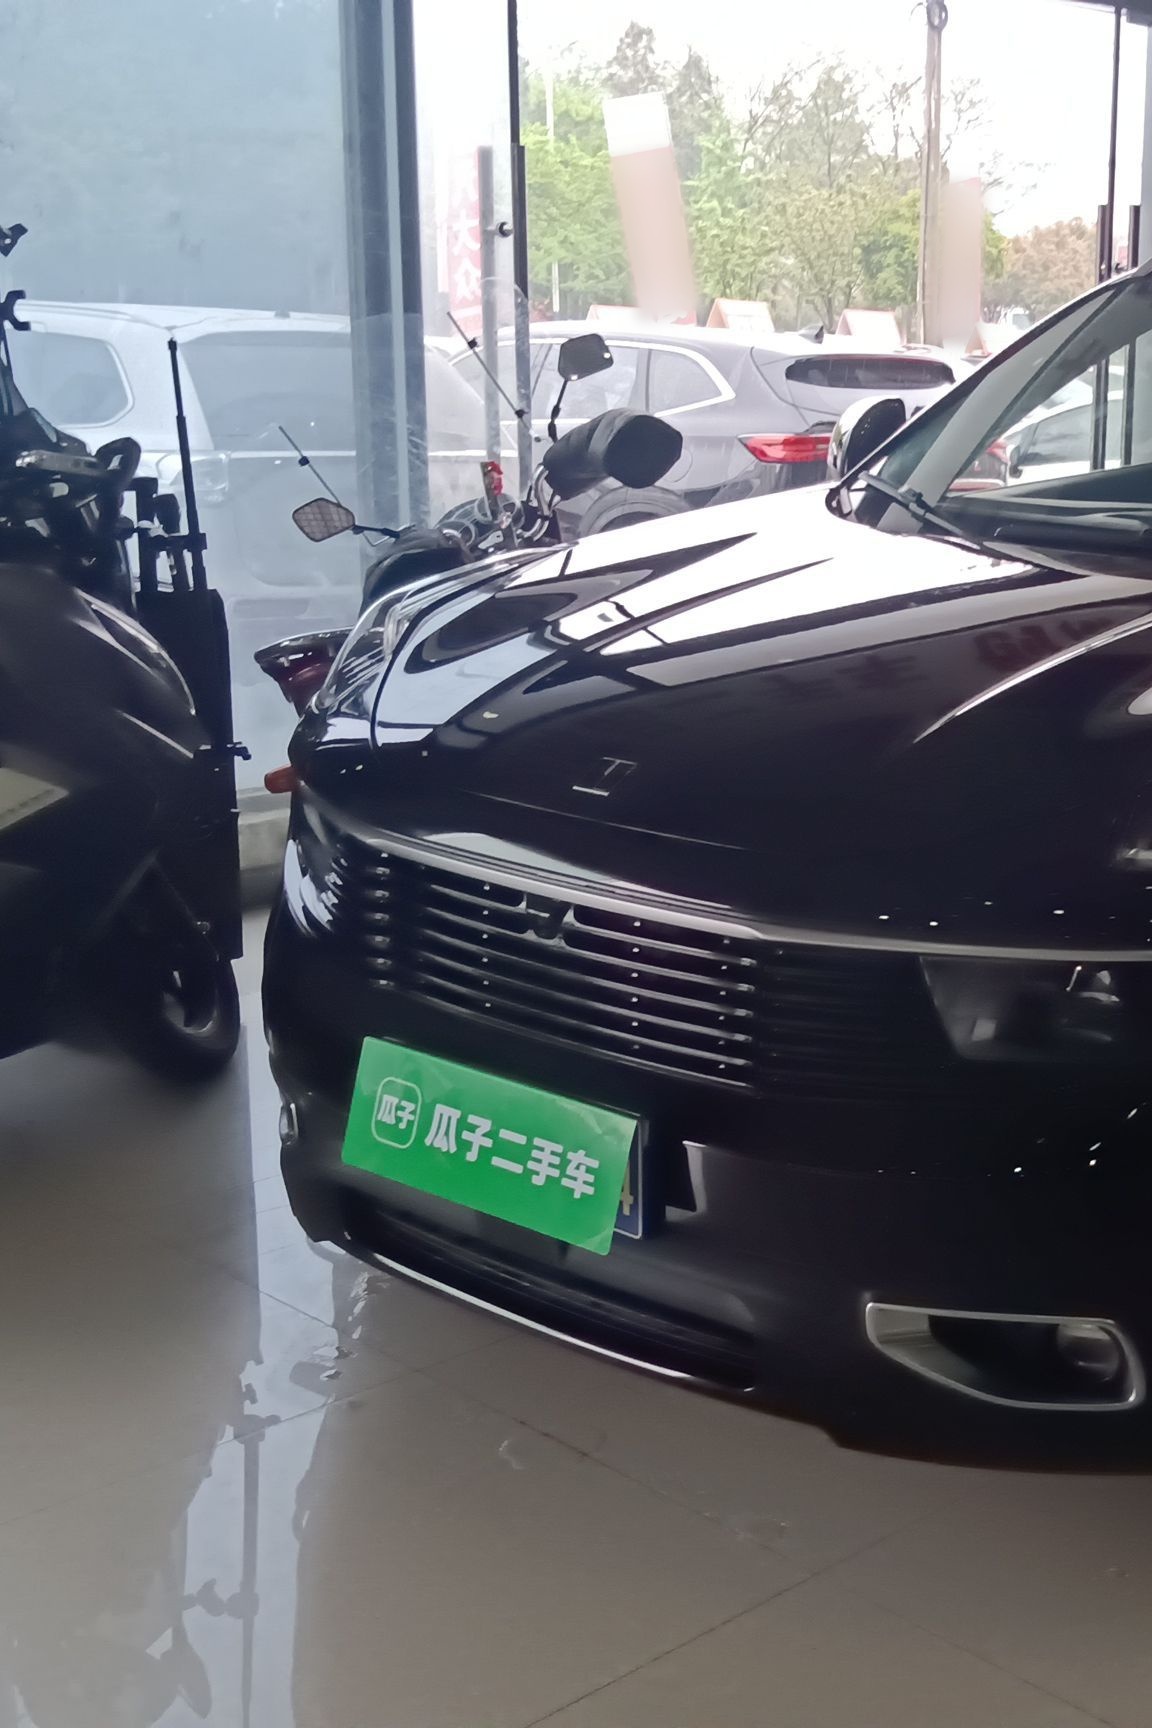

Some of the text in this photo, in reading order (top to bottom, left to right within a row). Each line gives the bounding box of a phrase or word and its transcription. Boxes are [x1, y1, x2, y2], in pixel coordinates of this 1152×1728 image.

[376, 1094, 416, 1129] 瓜子
[424, 1103, 600, 1199] 瓜子二手车
